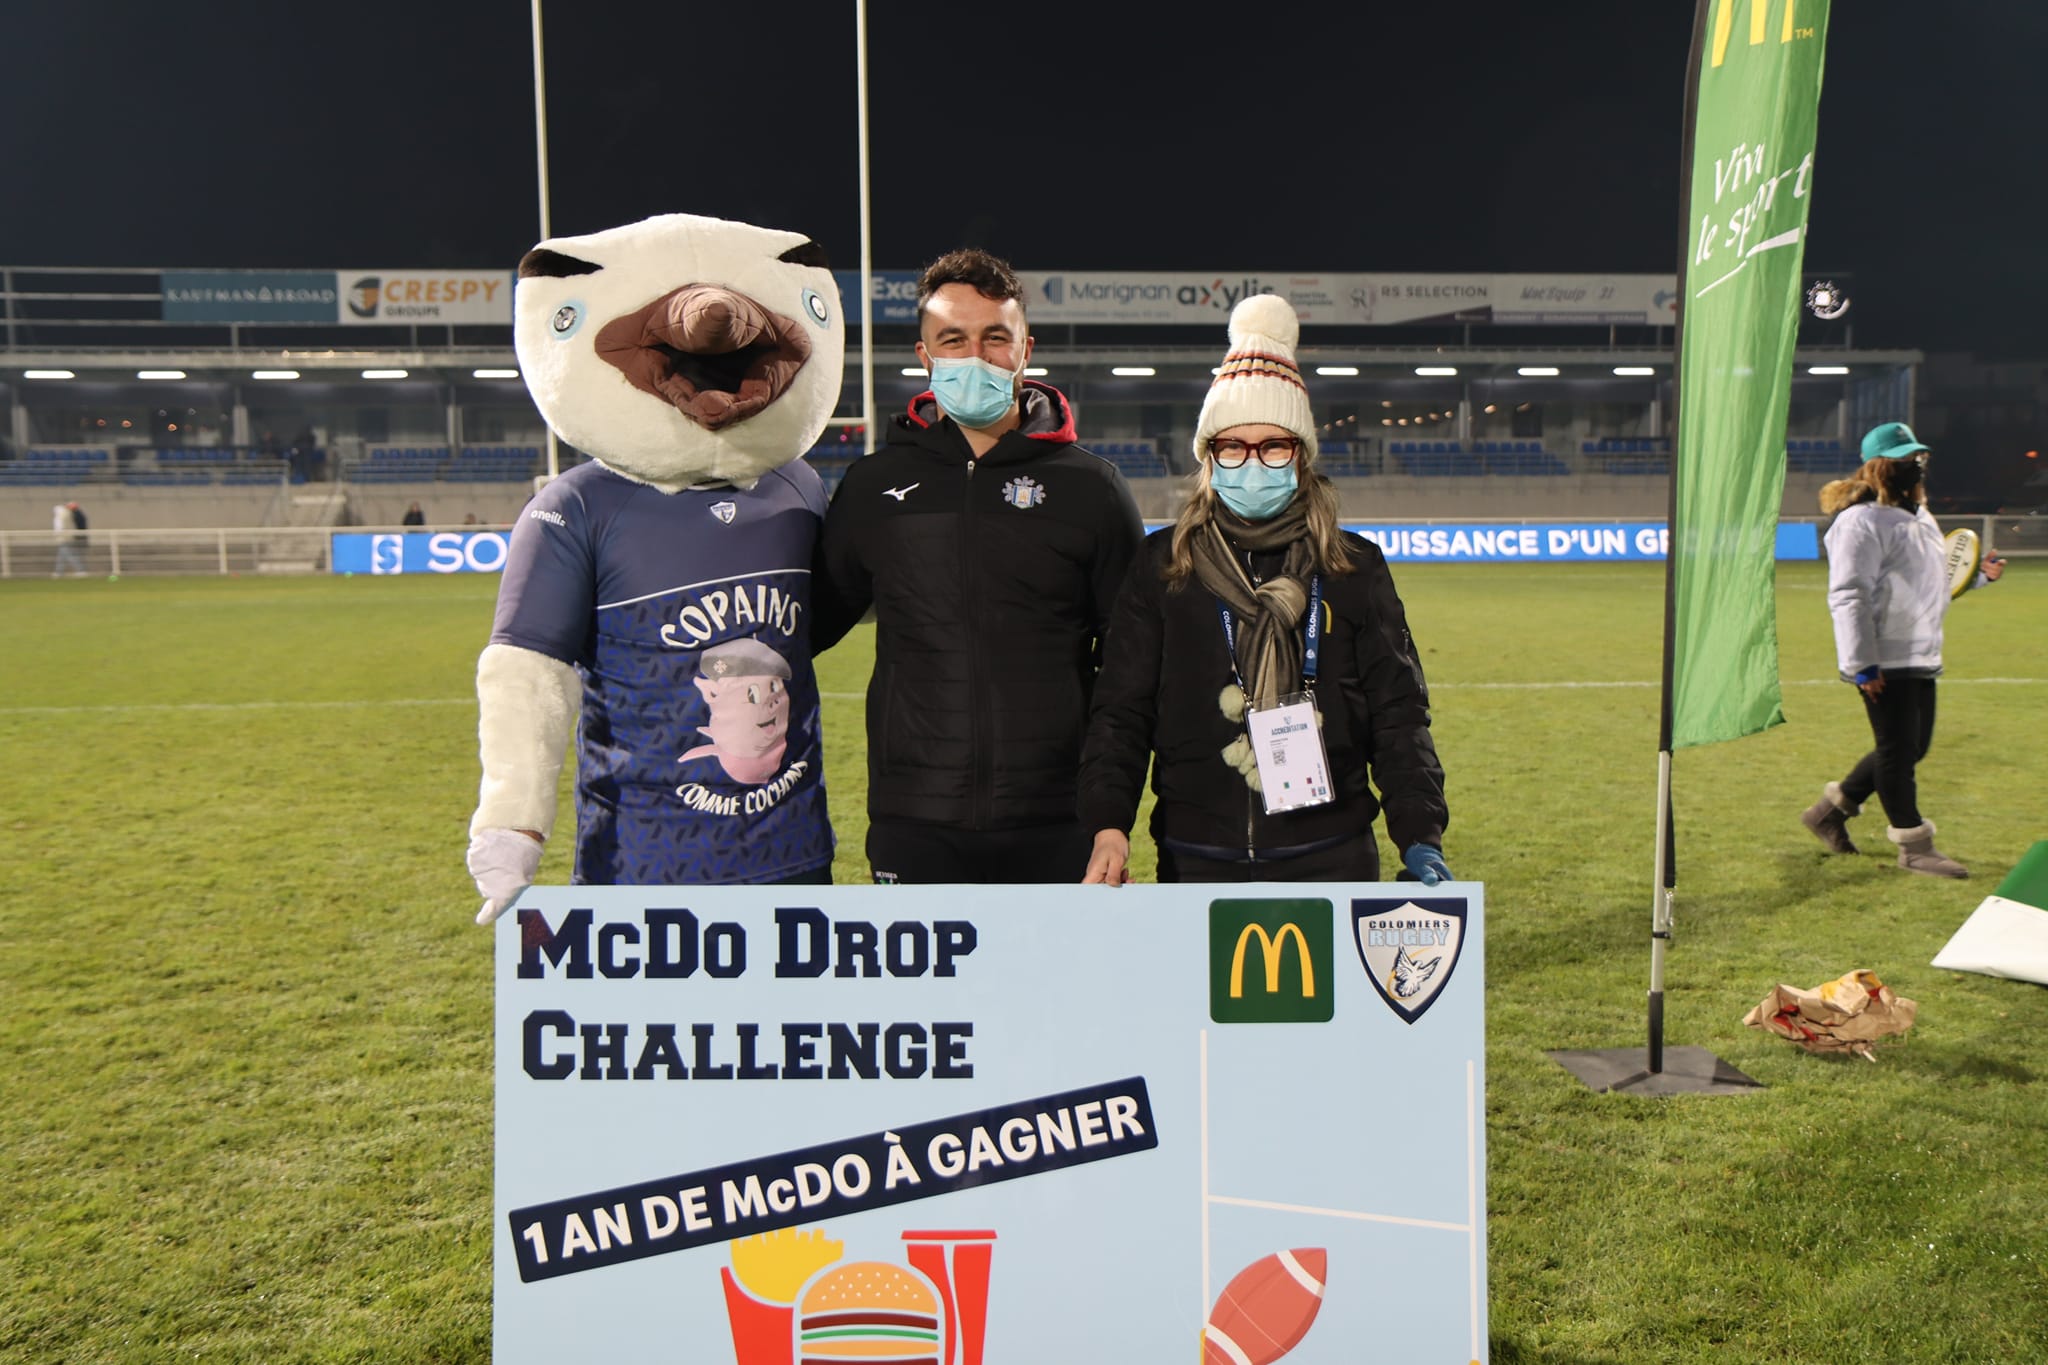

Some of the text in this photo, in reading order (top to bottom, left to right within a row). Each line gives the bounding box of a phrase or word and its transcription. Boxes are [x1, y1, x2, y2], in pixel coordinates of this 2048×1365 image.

[1795, 28, 1813, 39] TM
[1696, 152, 1812, 266] le sport
[385, 280, 501, 302] CRESPY
[1070, 282, 1171, 305] Marignan
[1381, 285, 1487, 297] RS SELECTION
[387, 306, 440, 317] GROUPE
[427, 531, 508, 573] SO
[1548, 529, 1626, 556] D'UN
[660, 585, 802, 648] COPAINS
[676, 761, 808, 815] COMME COCHONS
[1368, 919, 1451, 929] COLOMIERS
[1367, 928, 1450, 947] RUGBY
[522, 1222, 548, 1264] 1
[561, 1203, 633, 1259] AN
[641, 1186, 713, 1240] DE
[883, 1130, 921, 1188] À
[927, 1094, 1145, 1177] GAGNER
